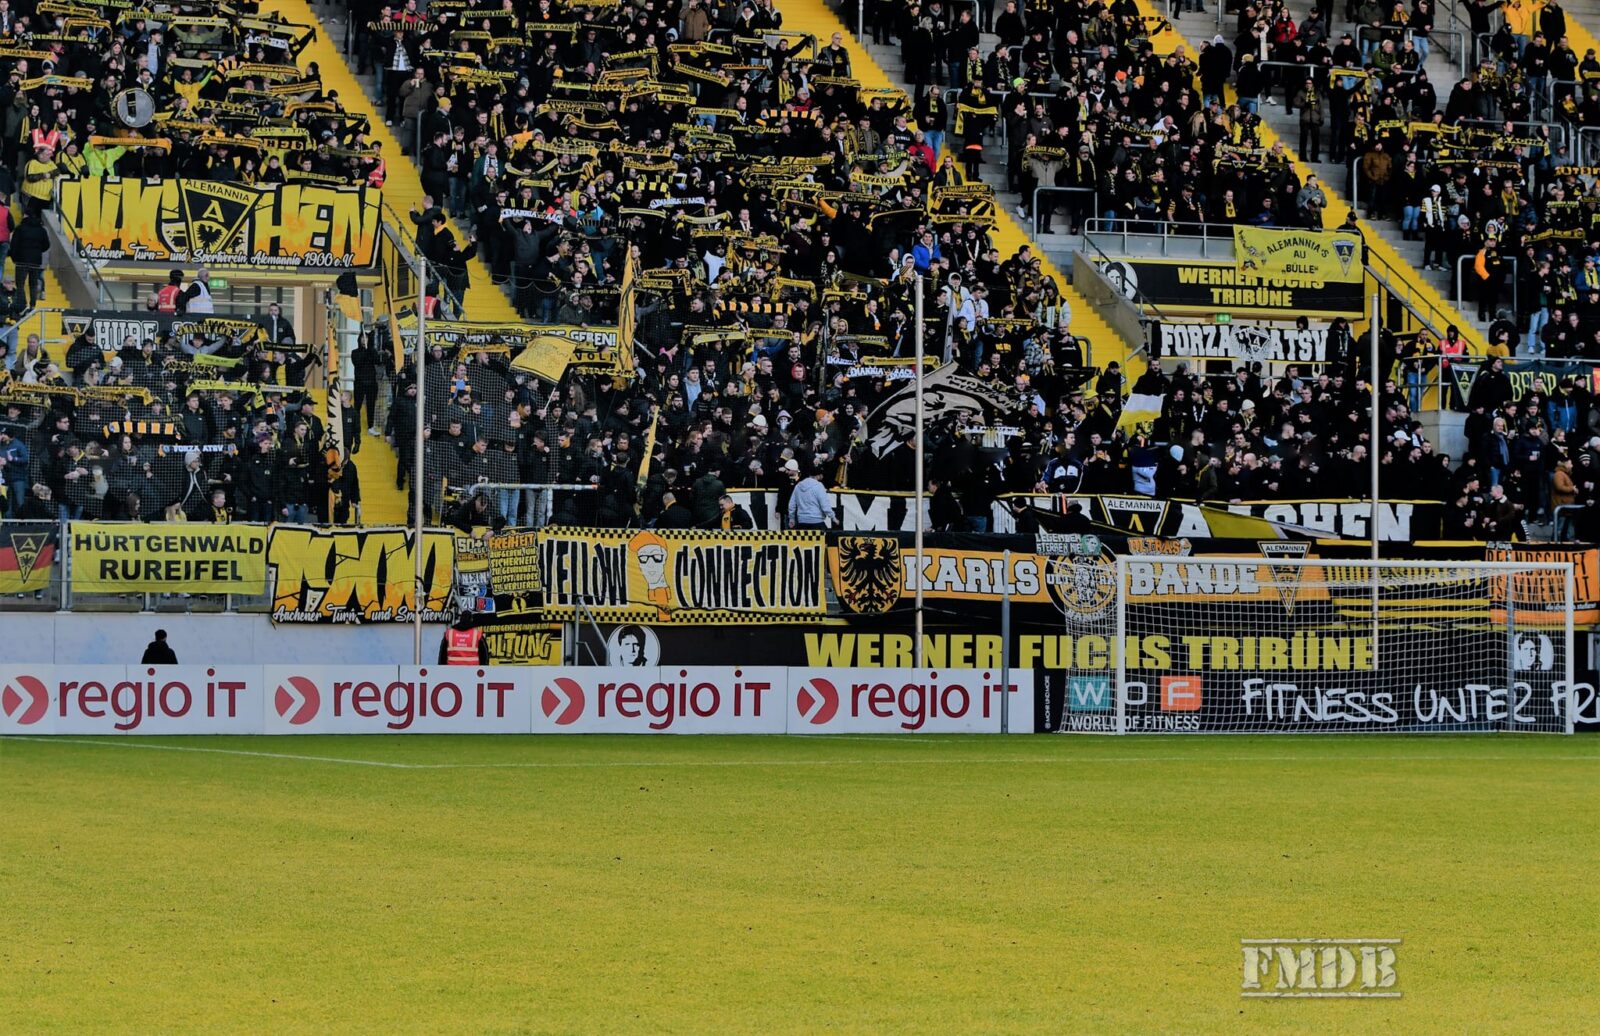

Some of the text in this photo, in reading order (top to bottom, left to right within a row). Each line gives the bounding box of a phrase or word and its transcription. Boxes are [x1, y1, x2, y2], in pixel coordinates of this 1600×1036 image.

[185, 178, 250, 201] ALEMANNIA
[80, 243, 125, 259] Aachener
[169, 248, 188, 262] und
[191, 249, 247, 264] Sportverein
[250, 250, 301, 266] Alemannia
[304, 252, 333, 267] 1900
[1293, 250, 1307, 259] AU
[1210, 287, 1293, 307] TRIBÜNE
[1160, 323, 1233, 358] FORZA
[1270, 328, 1329, 362] ATSV
[1107, 499, 1162, 511] ALEMANNIA
[1176, 503, 1414, 542] ACHEN
[75, 531, 264, 555] HÜRTGENWALD
[489, 532, 535, 551] FREIHEIT
[1035, 533, 1082, 543] LEGENDEN
[1128, 537, 1180, 554] ULTRAS
[1264, 545, 1306, 553] ALEMANNIA
[100, 559, 243, 581] RUREIFEL
[491, 555, 538, 568] SICHERHEIT
[540, 539, 820, 608] YELLOW CONNECTION
[503, 580, 540, 591] VERLIEREN
[903, 555, 1260, 595] KARLS BANDE
[272, 605, 323, 623] Aachener
[371, 607, 392, 622] und
[487, 632, 552, 660] ALTUNG
[804, 631, 1373, 671] WERNER FUCHS TRIBÜNE
[59, 668, 246, 731] regio iT
[334, 667, 515, 730] regio iT
[598, 669, 771, 730] regio iT
[851, 671, 970, 730] regio
[1243, 678, 1398, 723] FITNESS
[1416, 683, 1536, 723] UNTER
[1071, 716, 1200, 730] WORLD OF FITNESS
